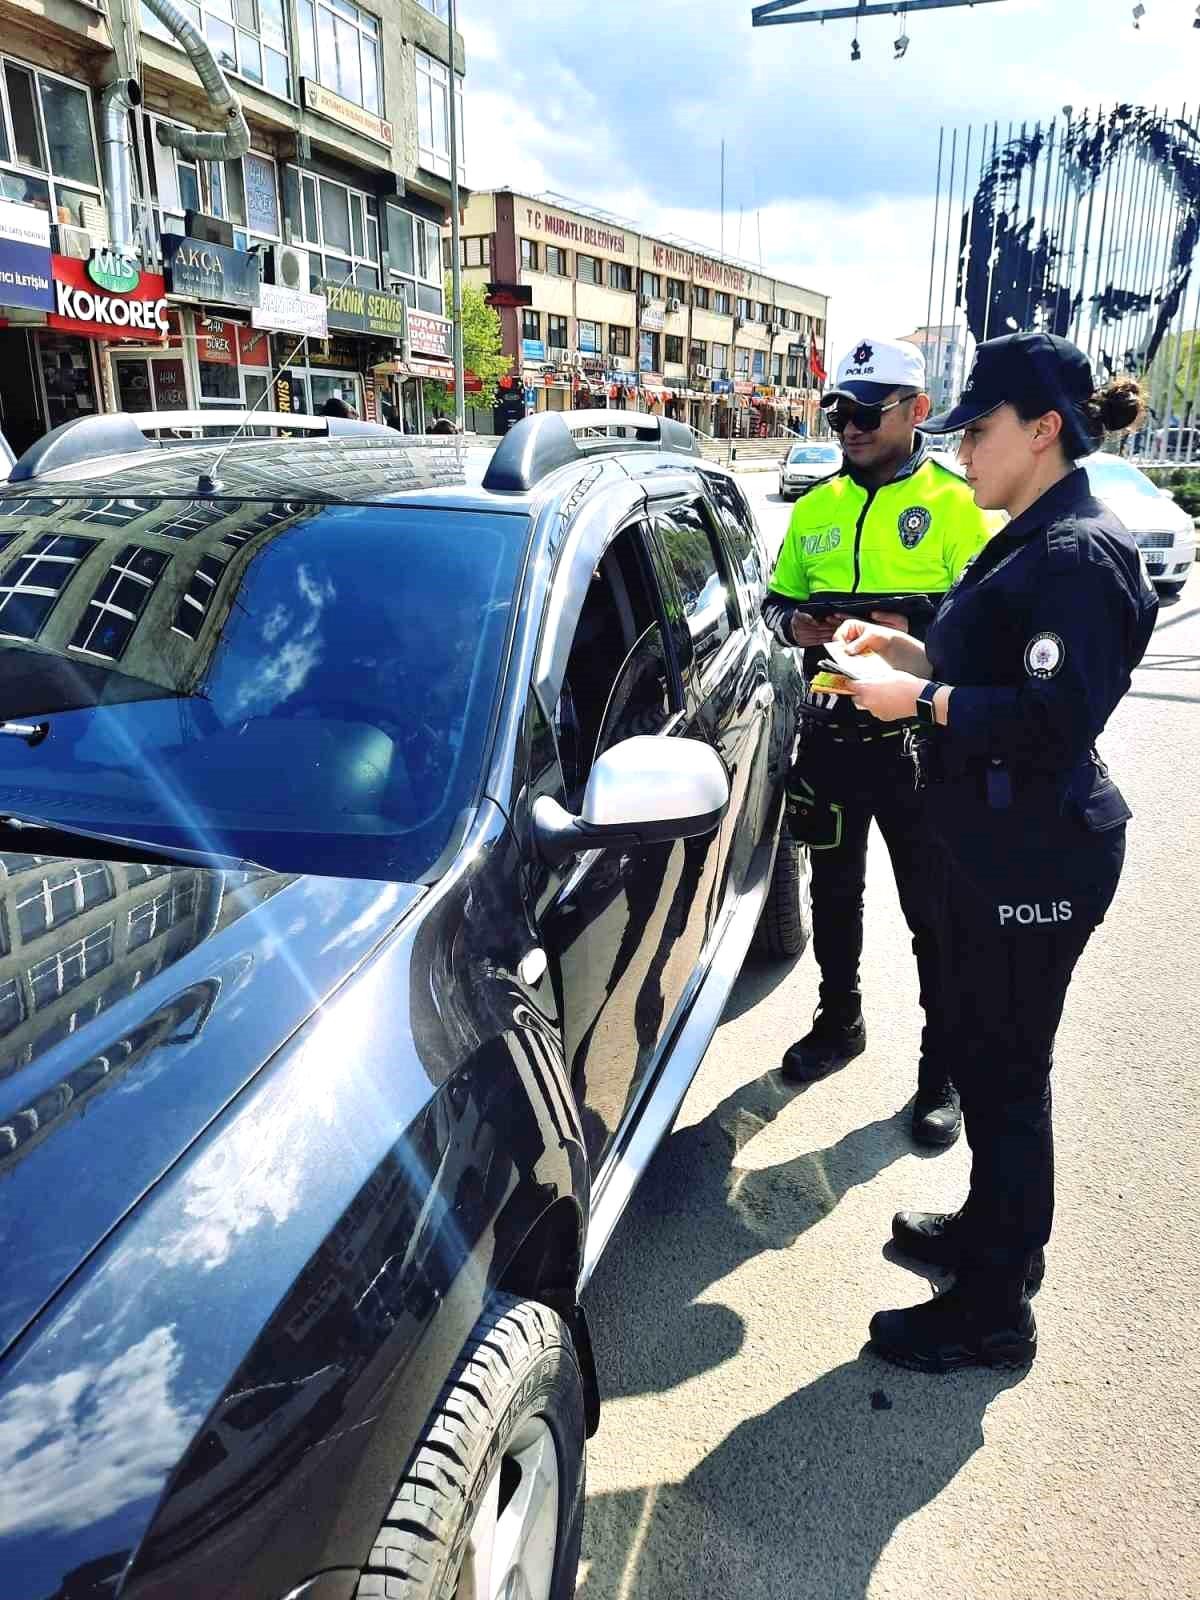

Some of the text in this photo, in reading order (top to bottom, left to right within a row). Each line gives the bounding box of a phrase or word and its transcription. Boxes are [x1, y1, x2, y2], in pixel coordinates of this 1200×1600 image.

[544, 214, 583, 242] MURATLI
[175, 246, 225, 275] AKÇA
[653, 245, 665, 267] NE
[56, 280, 169, 337] KOKOREÇ
